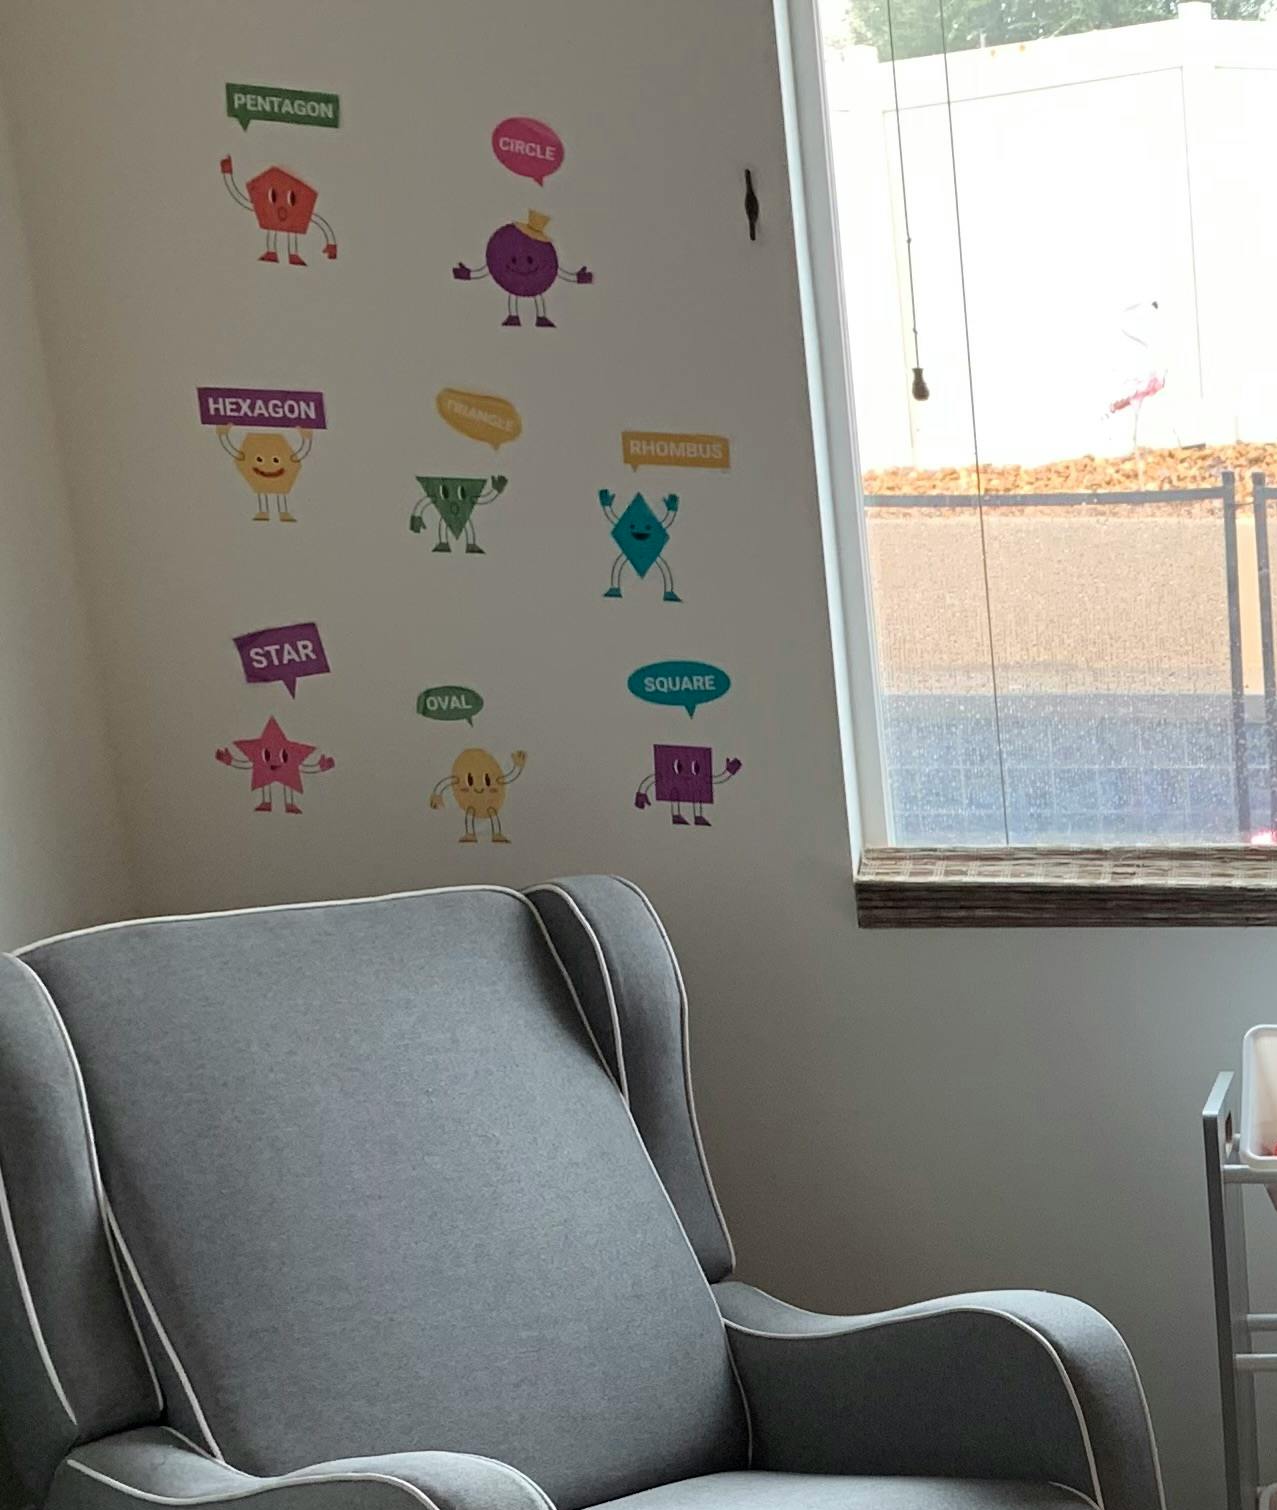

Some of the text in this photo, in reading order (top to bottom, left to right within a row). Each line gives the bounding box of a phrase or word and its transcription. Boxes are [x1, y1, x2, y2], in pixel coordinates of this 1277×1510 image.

[233, 93, 334, 119] PENTAGON
[498, 135, 557, 161] CIRCLE
[207, 396, 317, 420] HEXAGON
[446, 398, 516, 433] TRIANGLE
[629, 439, 724, 461] RHOMBUS
[249, 640, 317, 670] STAR
[643, 675, 716, 692] SQUARE
[425, 694, 473, 713] OVAL
